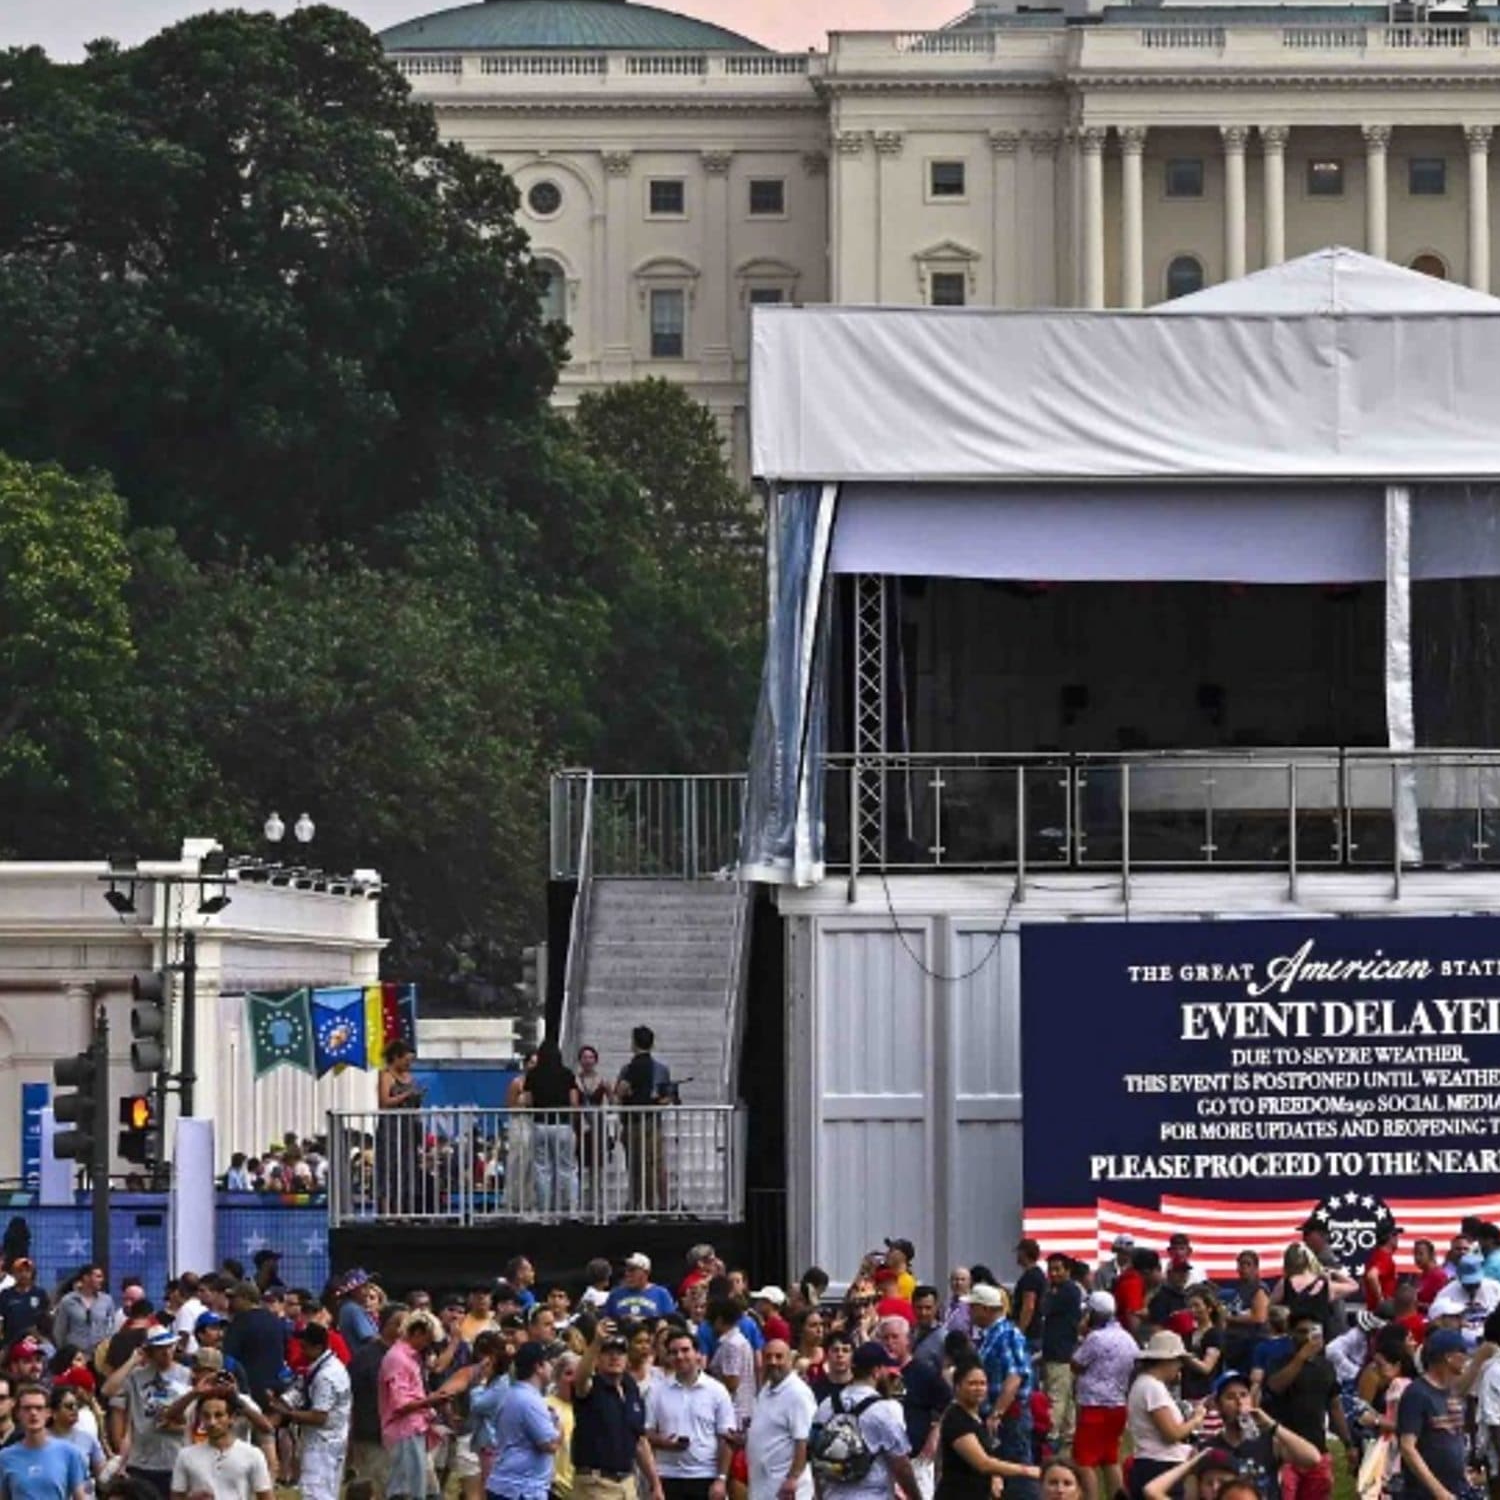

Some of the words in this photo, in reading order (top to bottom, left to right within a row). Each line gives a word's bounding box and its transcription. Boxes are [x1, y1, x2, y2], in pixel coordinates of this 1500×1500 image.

[1128, 965, 1173, 982] THE
[1179, 963, 1254, 982] GREAT
[1247, 938, 1433, 995] American
[1180, 1001, 1318, 1040] EVENT
[1231, 1048, 1272, 1066] DUE
[1273, 1048, 1300, 1065] TO
[1302, 1046, 1374, 1065] SEVERE
[1375, 1044, 1470, 1064] WEATHER,
[1123, 1074, 1168, 1093] THIS
[1169, 1073, 1232, 1092] EVENT
[1233, 1073, 1250, 1091] IS
[1252, 1071, 1360, 1091] POSTPONED
[1363, 1070, 1420, 1088] UNTIL
[1197, 1098, 1226, 1116] GO
[1227, 1097, 1255, 1115] TO
[1377, 1094, 1444, 1112] SOCIAL
[1160, 1122, 1198, 1141] FOR
[1199, 1122, 1254, 1140] MORE
[1255, 1120, 1338, 1139] UPDATES
[1340, 1119, 1379, 1138] AND
[1382, 1118, 1487, 1137] REOPENING
[1090, 1154, 1191, 1180] PLEASE
[1193, 1152, 1322, 1179] PROCEED
[1325, 1151, 1364, 1177] TO
[1367, 1151, 1422, 1176] THE
[1329, 1230, 1377, 1257] 250
